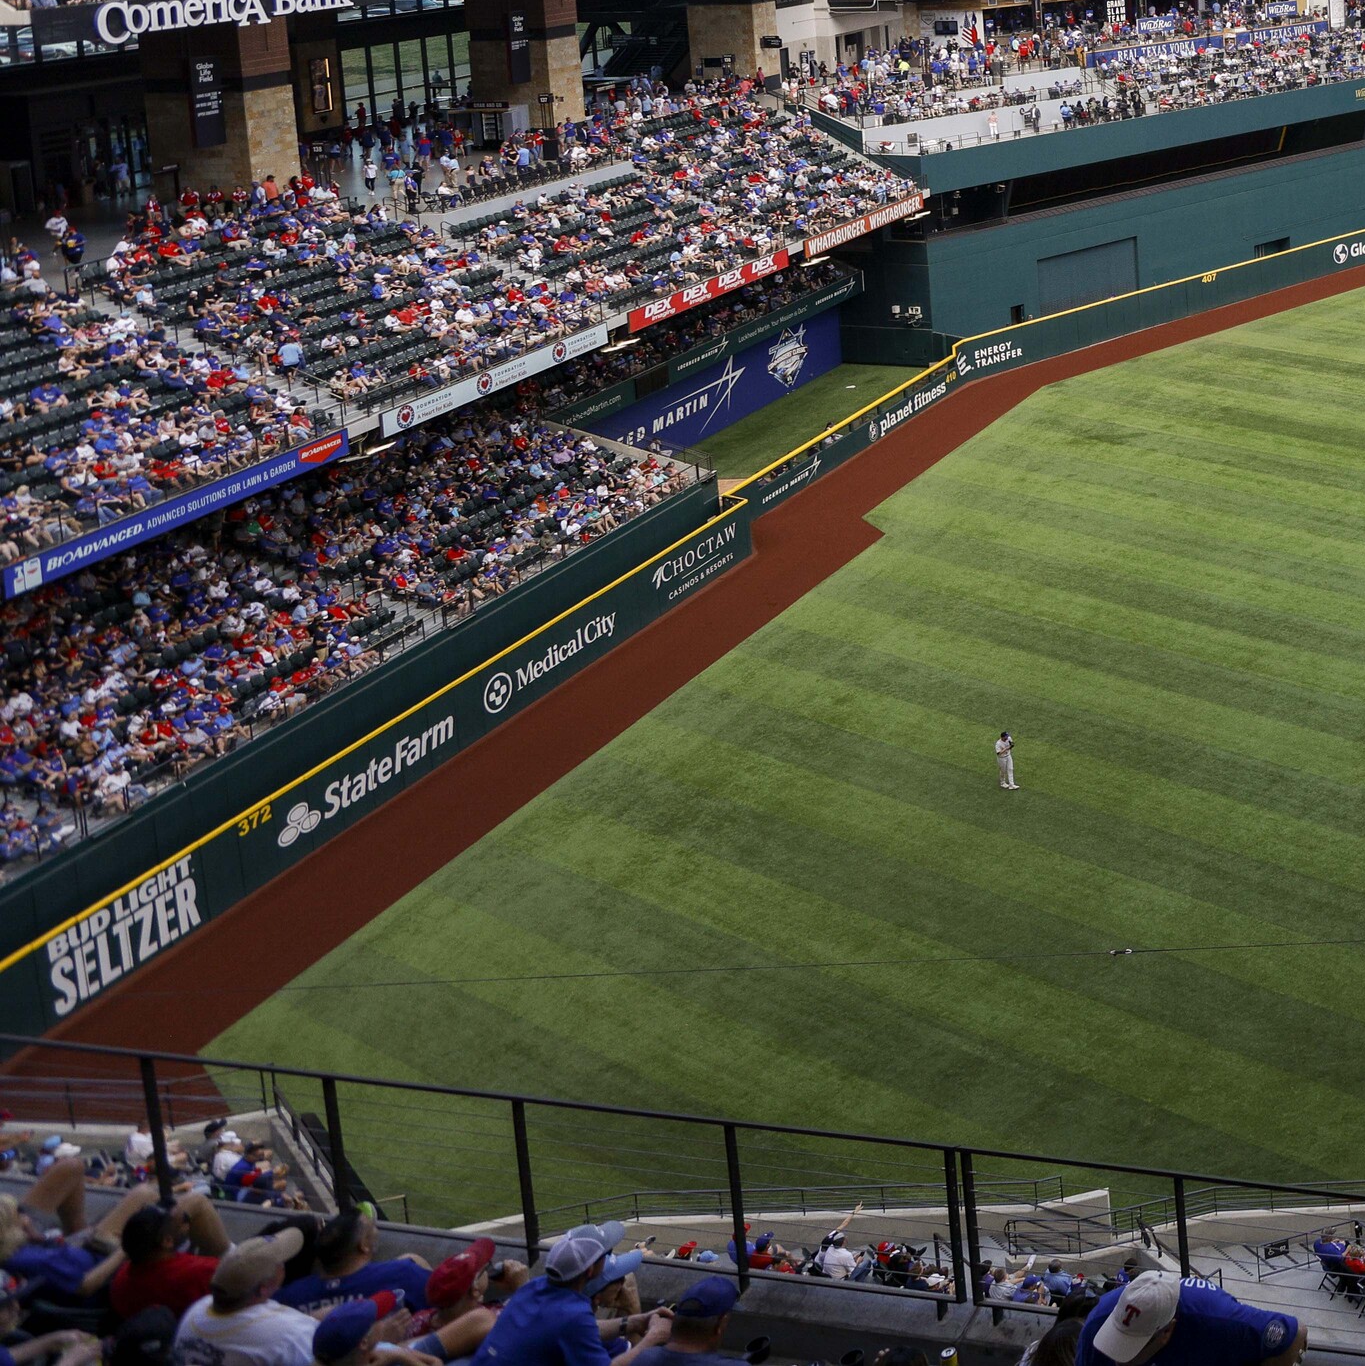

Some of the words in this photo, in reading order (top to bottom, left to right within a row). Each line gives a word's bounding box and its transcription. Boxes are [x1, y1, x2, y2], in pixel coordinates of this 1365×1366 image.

[1107, 0, 1125, 8] GRAND
[1117, 48, 1137, 60] REAL
[1143, 45, 1166, 56] TEXAS
[1169, 42, 1195, 53] VODKA
[808, 220, 866, 255] WHATABURGER
[870, 196, 921, 229] WHATABURGER
[718, 268, 743, 287] DEX
[751, 254, 775, 273] DEX
[1202, 273, 1217, 283] 407
[683, 283, 708, 302] DEX
[974, 341, 1012, 360] ENERGY
[976, 347, 1023, 369] TRANSFER
[945, 371, 956, 384] 410
[562, 394, 622, 426] LockheedMartin.com
[653, 393, 709, 430] MARTIN
[880, 403, 915, 435] planet
[913, 381, 947, 413] fitness
[147, 506, 186, 530] ADVANCED
[187, 489, 227, 514] SOLUTIONS
[228, 482, 242, 496] FOR
[243, 474, 262, 490] LAWN
[270, 459, 296, 479] GARDEN
[762, 481, 790, 504] LOCKHEED
[790, 471, 809, 489] MARTIN
[660, 522, 737, 583] CHOCTAW
[669, 577, 699, 600] CASINOS
[705, 552, 733, 574] RESORTS
[515, 634, 585, 690] Medical
[583, 610, 617, 652] City
[239, 805, 272, 836] 372
[47, 907, 111, 963] BUD
[114, 854, 194, 919] LIGHT
[50, 878, 201, 1016] SELTZER
[1122, 1304, 1141, 1327] T
